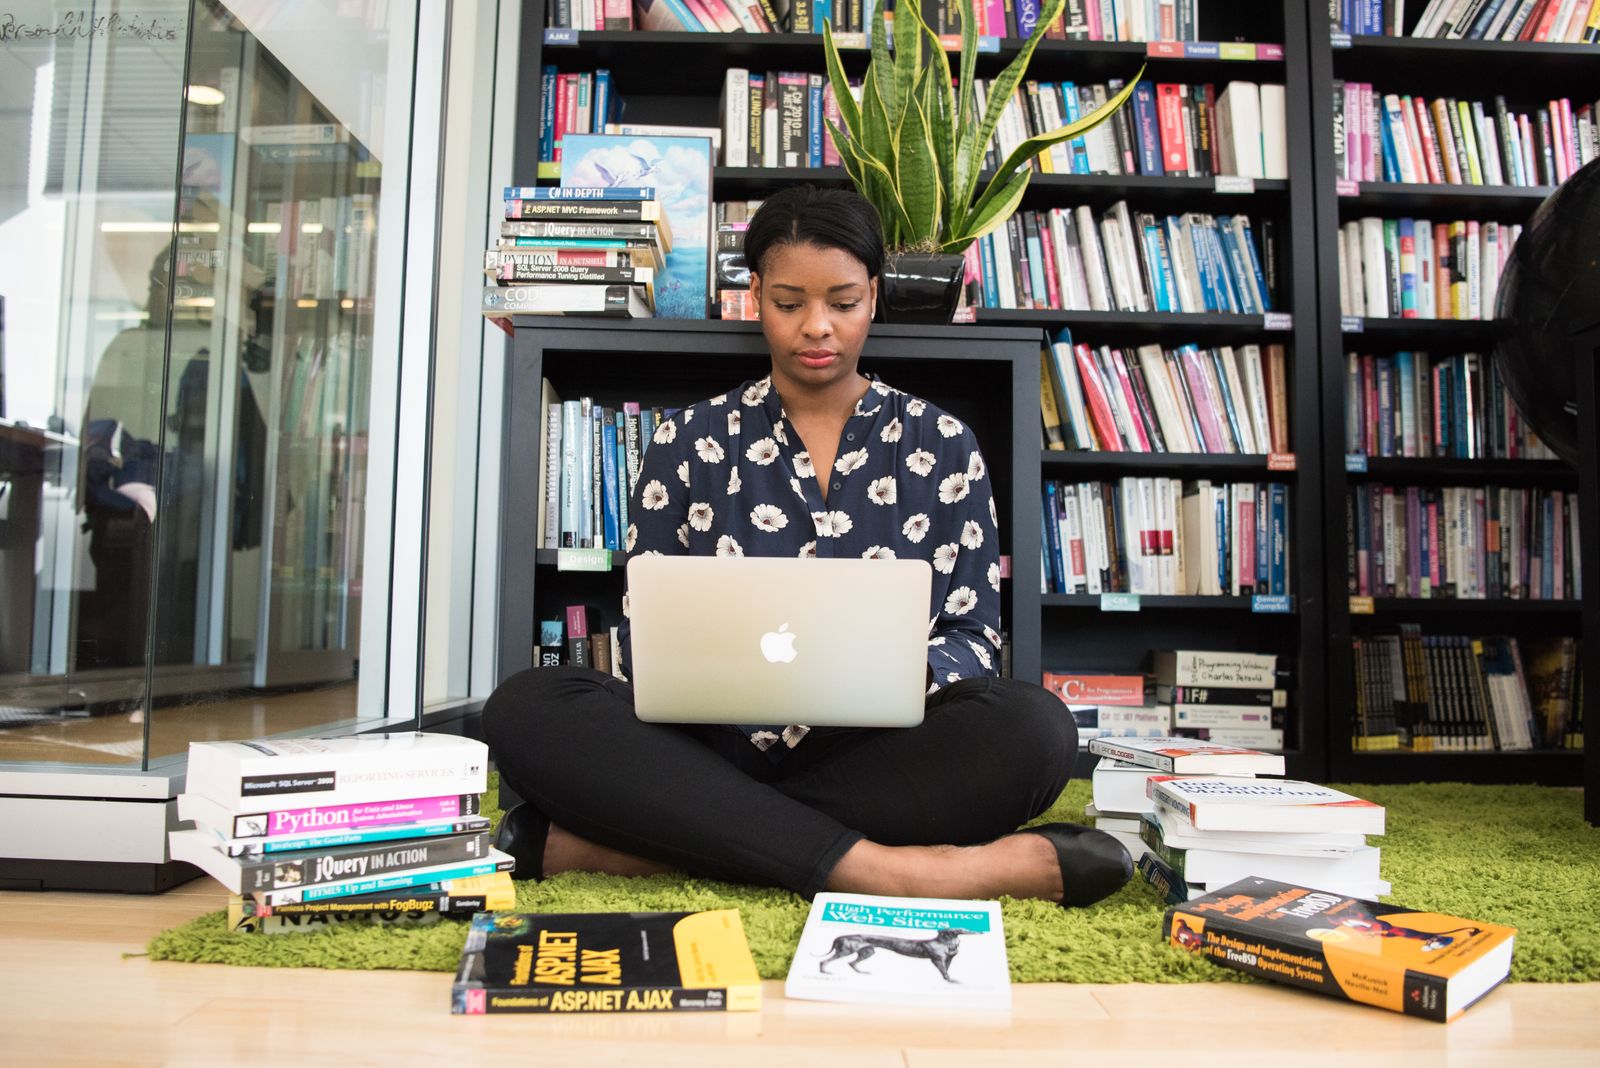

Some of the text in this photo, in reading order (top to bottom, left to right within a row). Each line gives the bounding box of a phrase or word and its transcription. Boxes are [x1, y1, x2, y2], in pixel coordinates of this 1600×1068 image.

[752, 96, 761, 115] LINQ
[793, 106, 802, 128] 2010
[783, 118, 792, 150] Platform
[563, 188, 573, 197] IN
[575, 188, 604, 198] DEPTH
[532, 206, 560, 215] ASP.NET
[562, 206, 578, 214] MVC
[579, 205, 618, 215] Framework
[543, 223, 576, 238] jQuery
[503, 253, 556, 265] PYTHON
[516, 272, 605, 281] Performance Tuning Distilled
[533, 264, 552, 272] Server
[570, 265, 589, 274] Query
[628, 418, 637, 439] Holub
[1191, 689, 1209, 703] F#
[275, 808, 350, 833] Python
[314, 848, 427, 882] jQuery IN ACTION
[389, 900, 434, 912] FogBugz
[827, 903, 984, 920] High Performance
[828, 911, 950, 929] Web Sites
[534, 930, 578, 985] ASP.NET
[1207, 931, 1323, 970] The Design and Implementation
[580, 948, 622, 985] AJAX
[1214, 946, 1227, 958] the
[1227, 949, 1257, 966] FreeBSD
[1257, 957, 1296, 976] Operating
[1295, 966, 1324, 983] System
[550, 990, 624, 1011] ASP.NET
[626, 989, 673, 1009] AJAX
